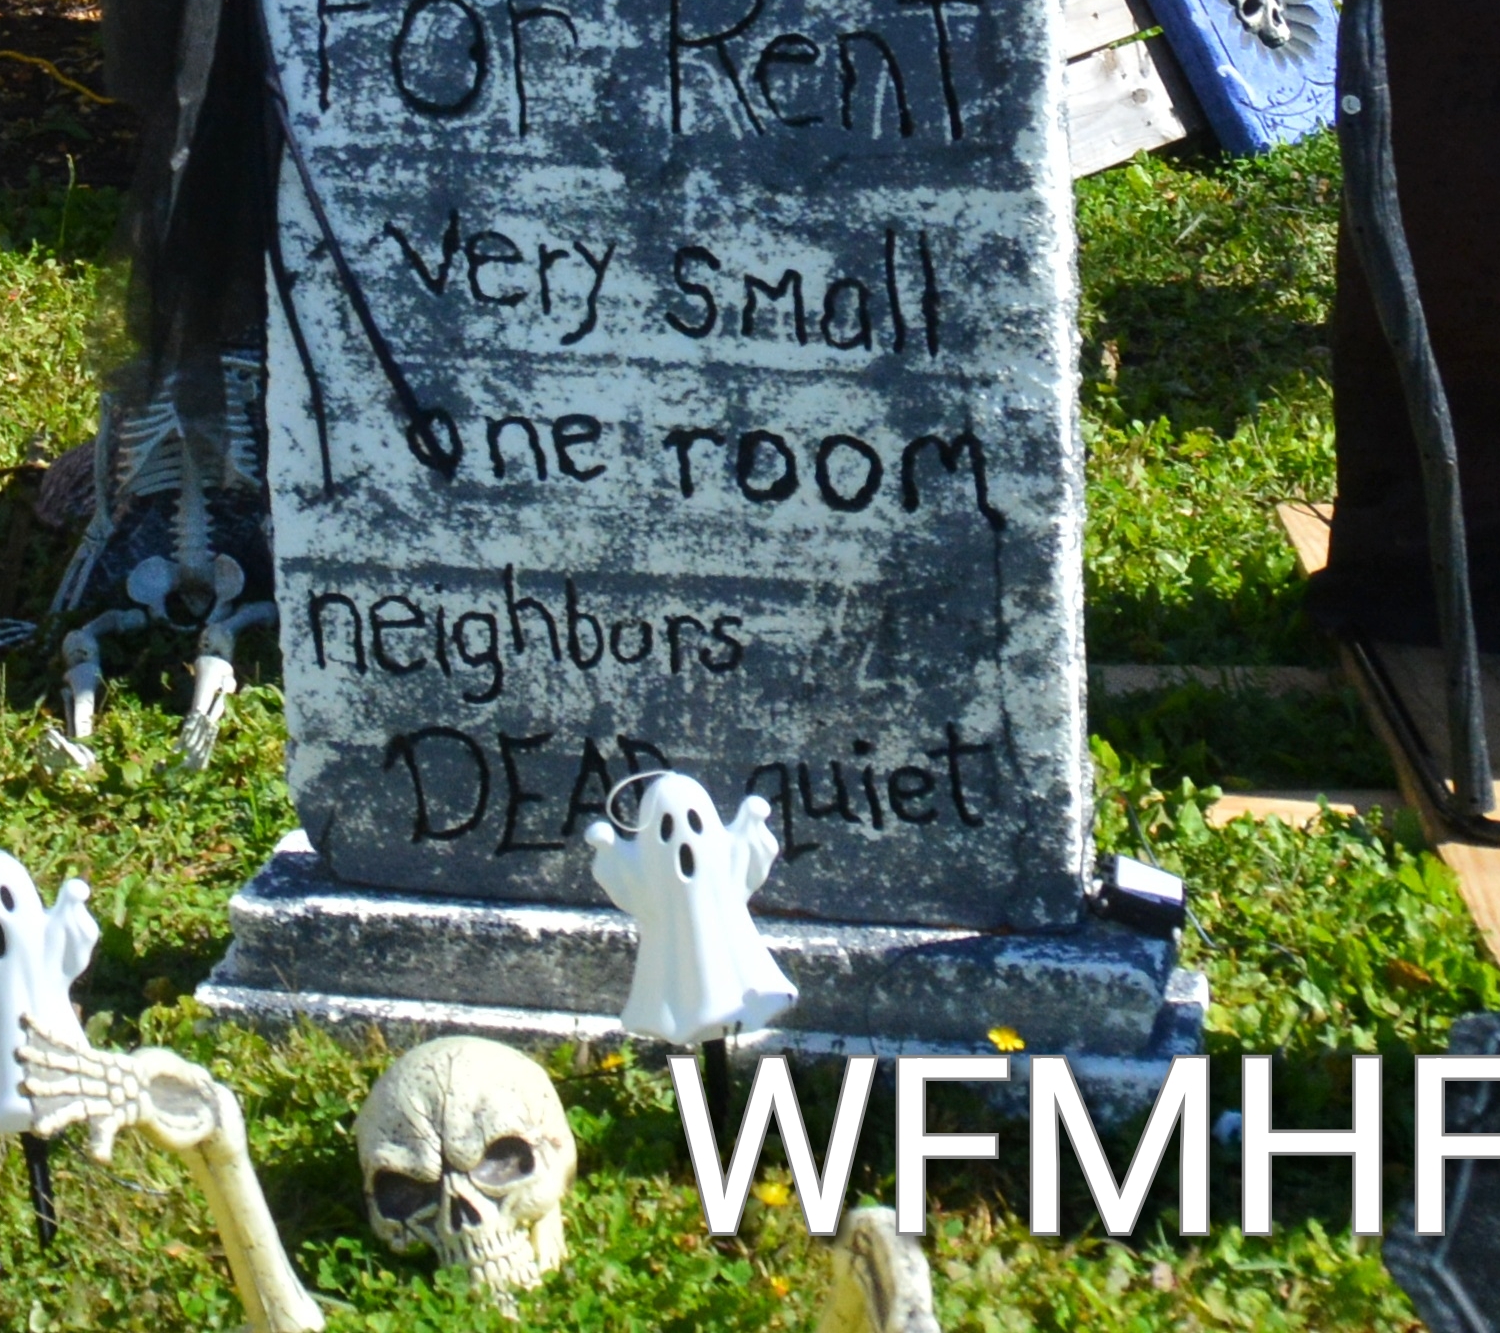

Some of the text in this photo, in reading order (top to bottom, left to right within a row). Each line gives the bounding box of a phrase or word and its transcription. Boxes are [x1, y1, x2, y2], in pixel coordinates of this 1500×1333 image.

[405, 407, 1002, 523] one room
[307, 562, 745, 705] neighbors
[744, 722, 994, 863] quiet
